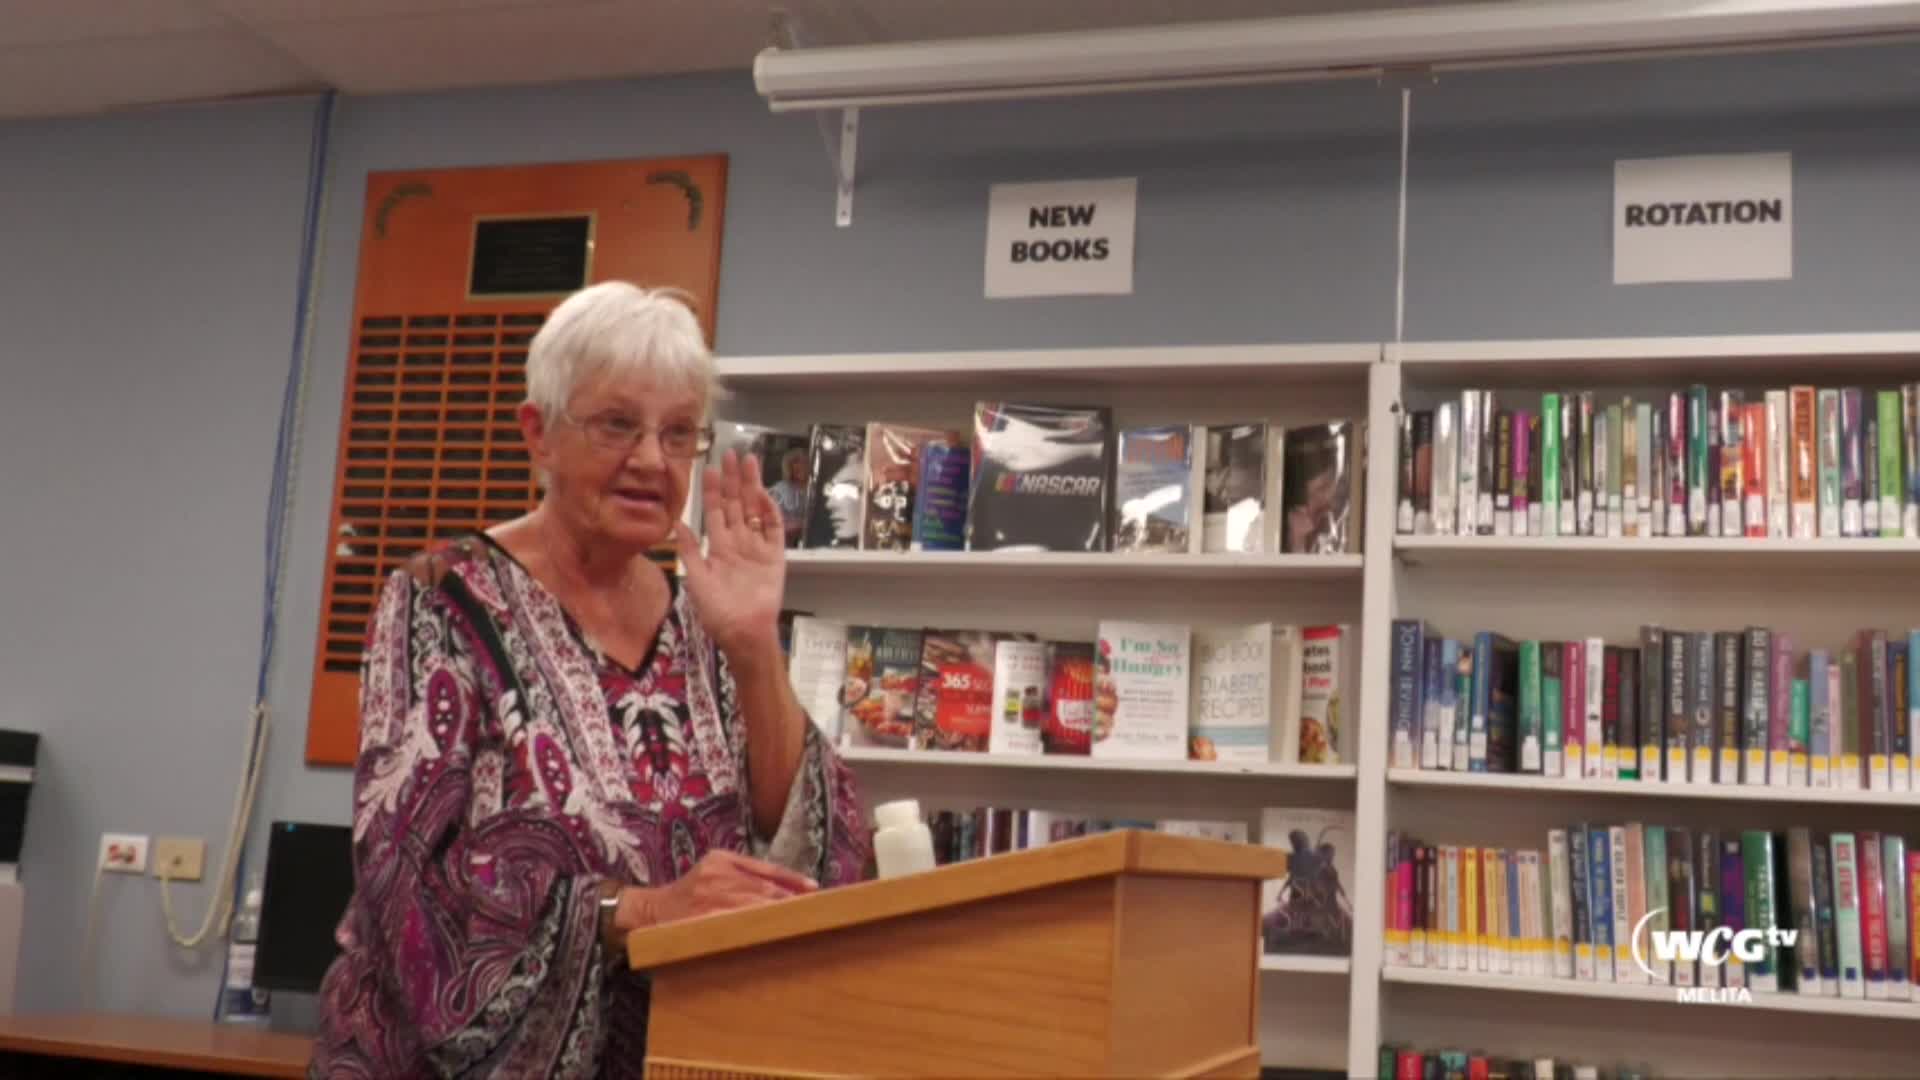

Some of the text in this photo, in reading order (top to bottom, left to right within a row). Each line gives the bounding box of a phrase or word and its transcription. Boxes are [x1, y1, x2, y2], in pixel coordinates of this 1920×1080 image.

[1028, 202, 1097, 229] NEW
[1625, 198, 1782, 228] ROTATION
[1010, 236, 1110, 264] BOOKS
[1020, 473, 1101, 496] NASCAR
[1113, 657, 1183, 677] Hungry
[941, 673, 971, 688] 365
[1200, 696, 1265, 720] RECIPES
